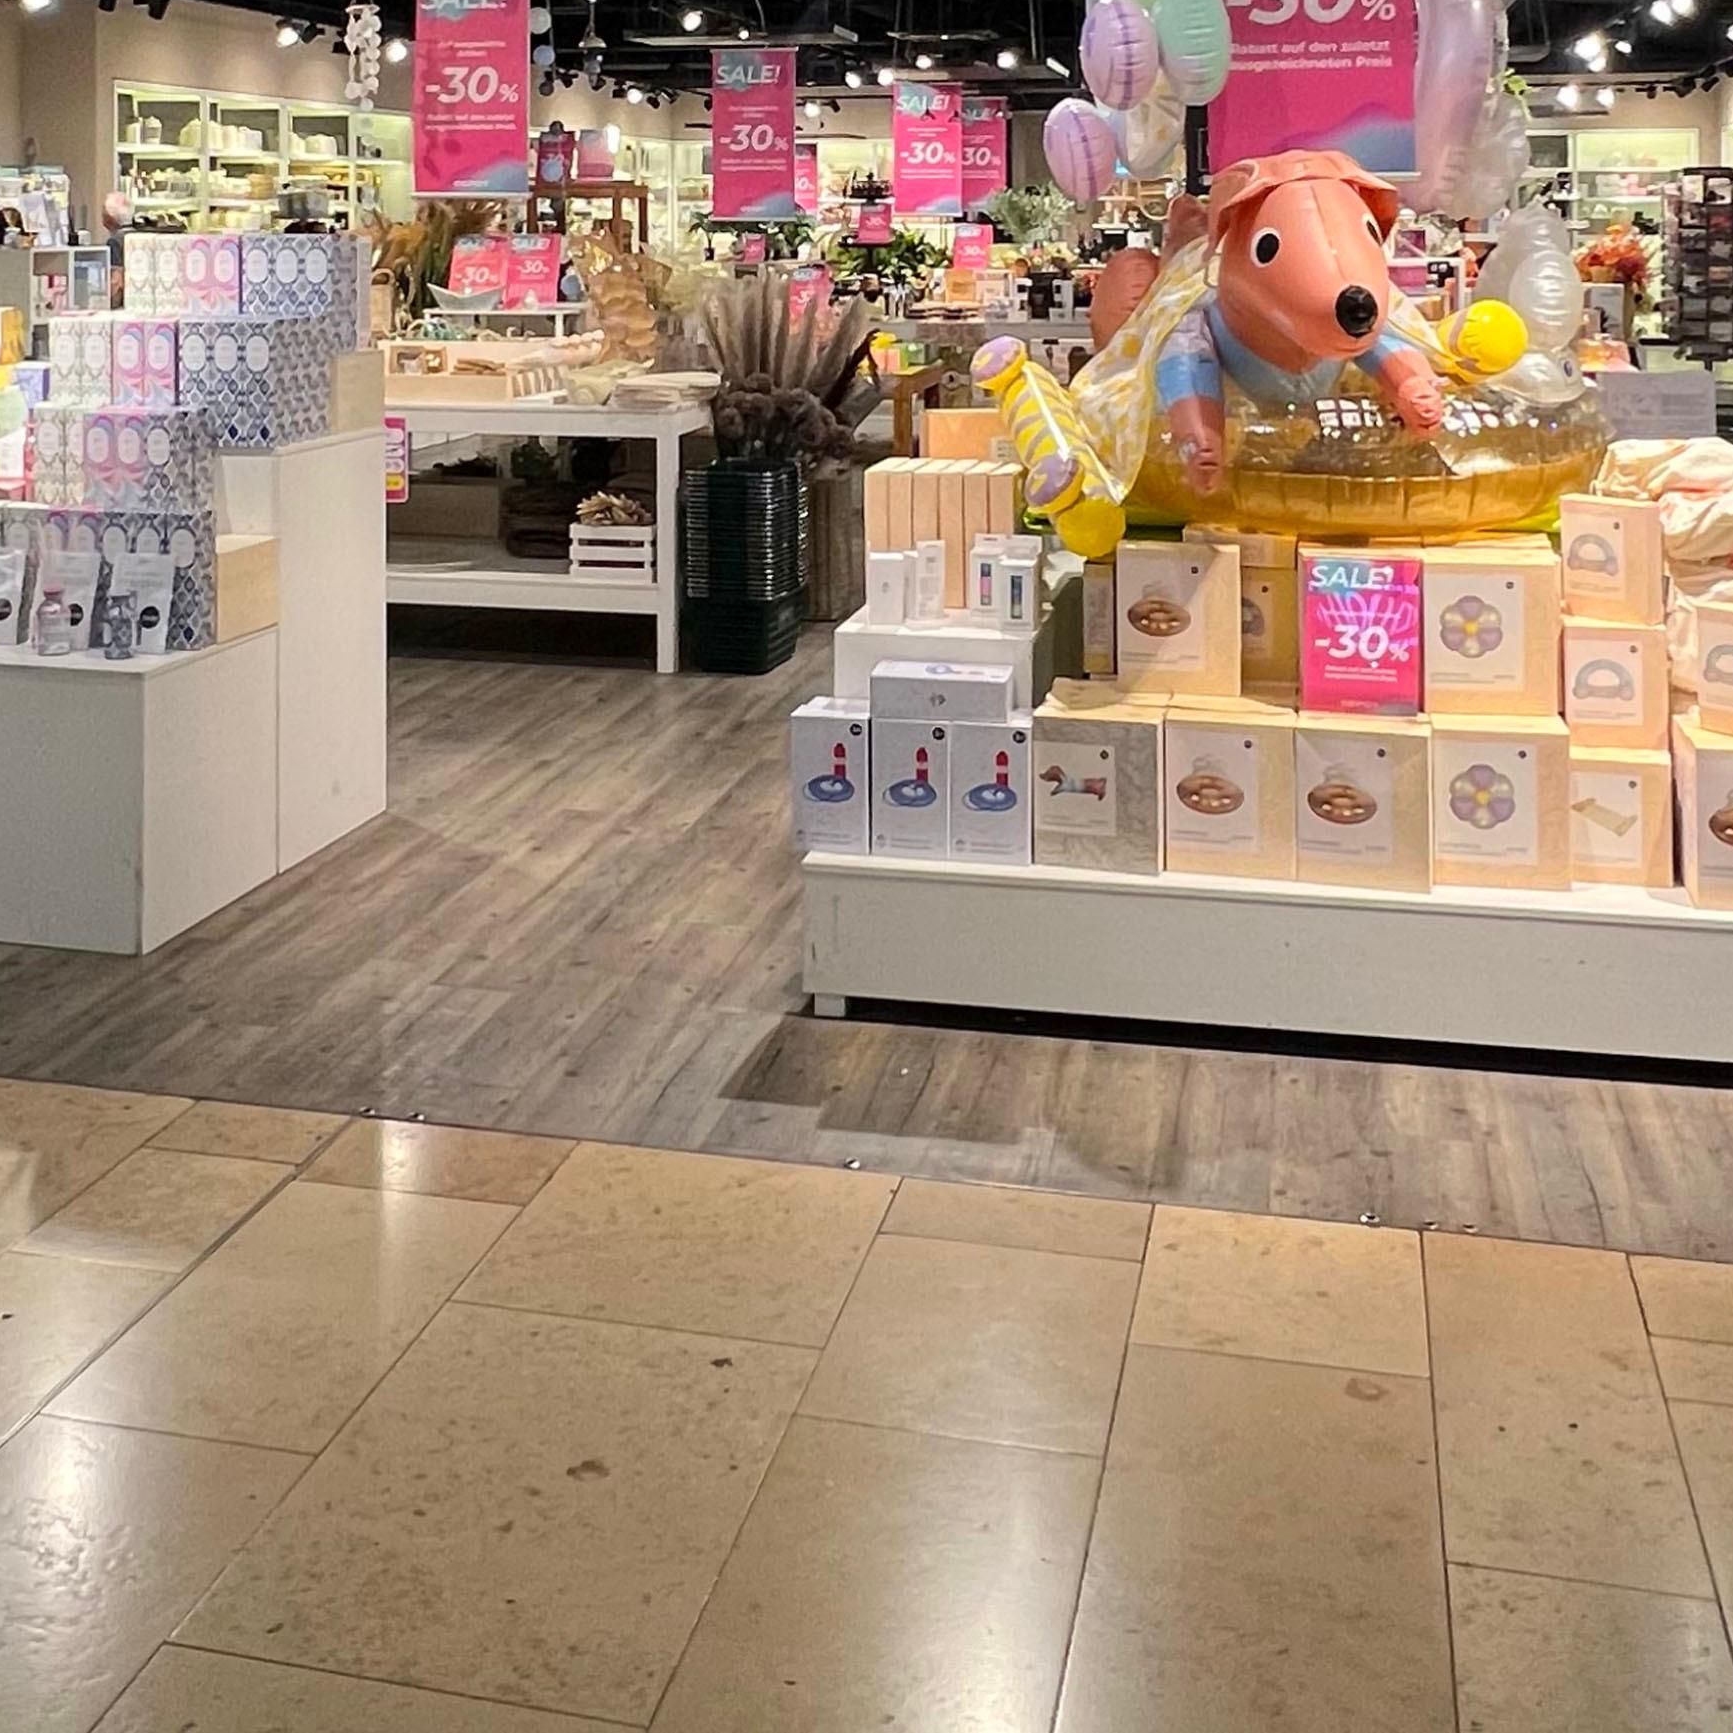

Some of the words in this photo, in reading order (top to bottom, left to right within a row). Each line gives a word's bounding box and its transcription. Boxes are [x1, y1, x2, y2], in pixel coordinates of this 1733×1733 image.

[425, 66, 519, 104] -30%
[715, 65, 782, 84] SALE!
[720, 124, 789, 152] -30%
[963, 146, 1002, 166] 30%
[1311, 565, 1395, 590] SALE!
[1315, 623, 1410, 662] -30%
